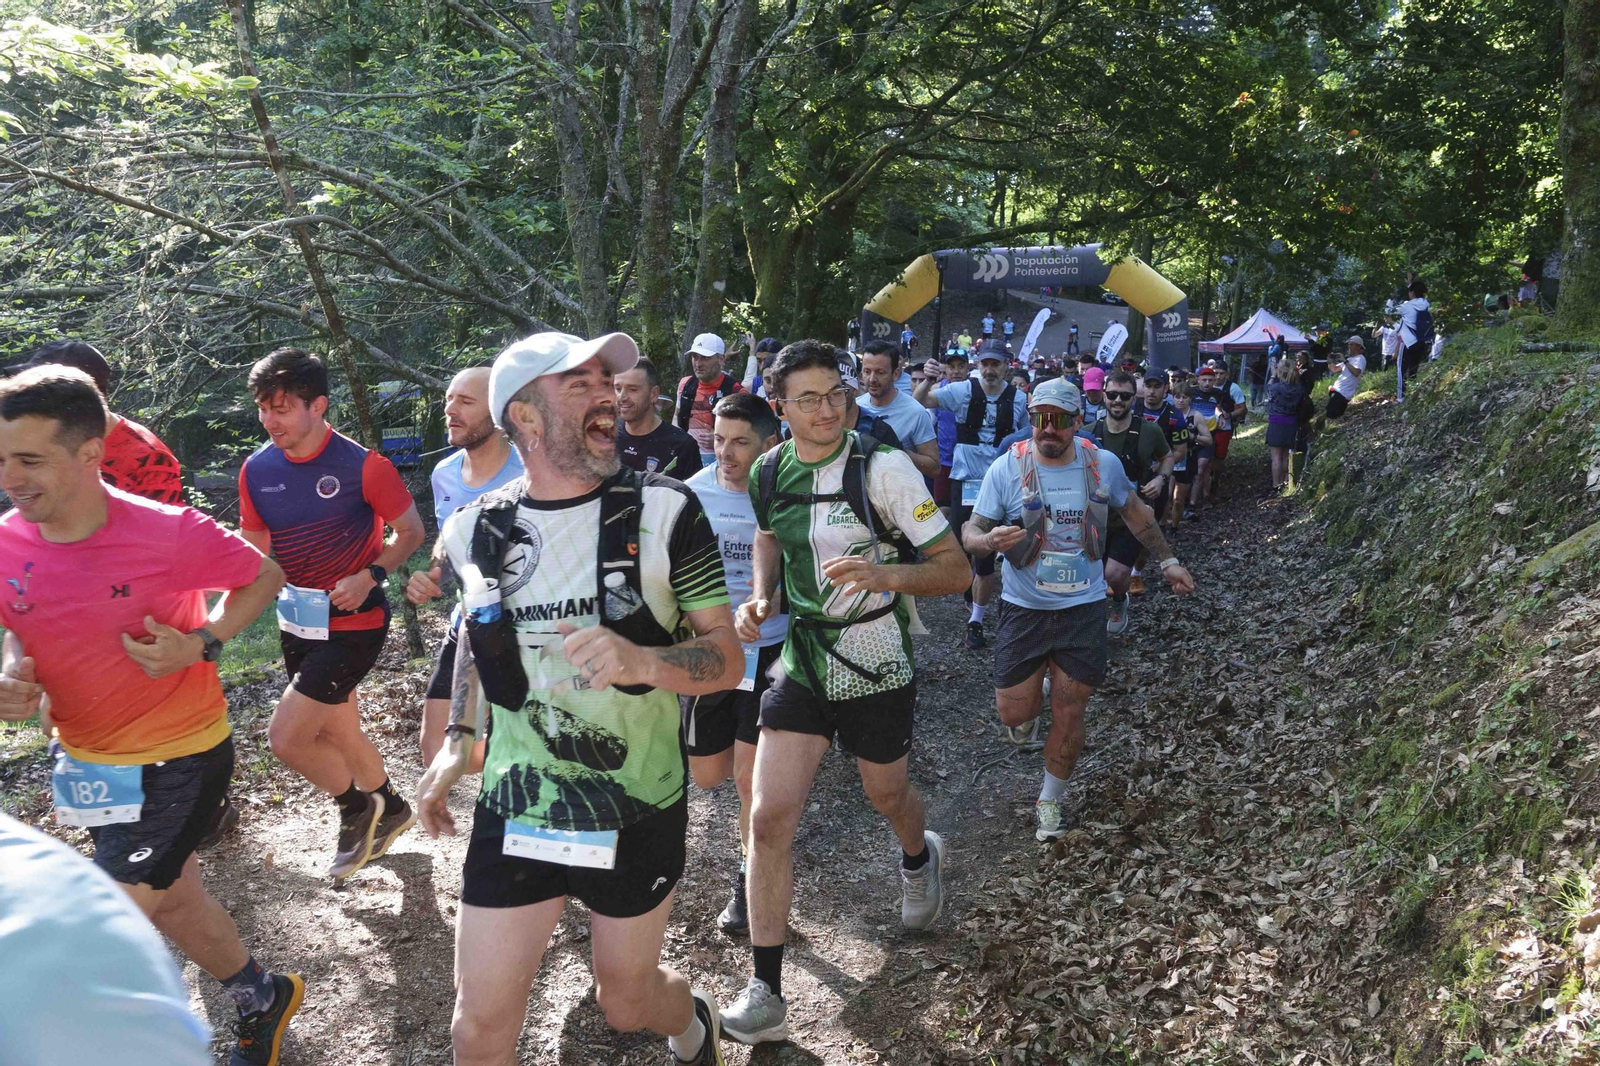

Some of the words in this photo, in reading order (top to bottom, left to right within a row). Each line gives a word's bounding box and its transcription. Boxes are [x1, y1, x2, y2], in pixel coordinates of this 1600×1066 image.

[1014, 254, 1079, 268] Deputación
[1014, 266, 1079, 276] Pontevedra
[1172, 428, 1189, 442] 20
[1056, 509, 1084, 517] Entre
[724, 541, 754, 551] Entre
[724, 550, 754, 561] Cast
[1056, 569, 1077, 582] 311
[293, 607, 299, 622] 1
[69, 780, 113, 805] 182
